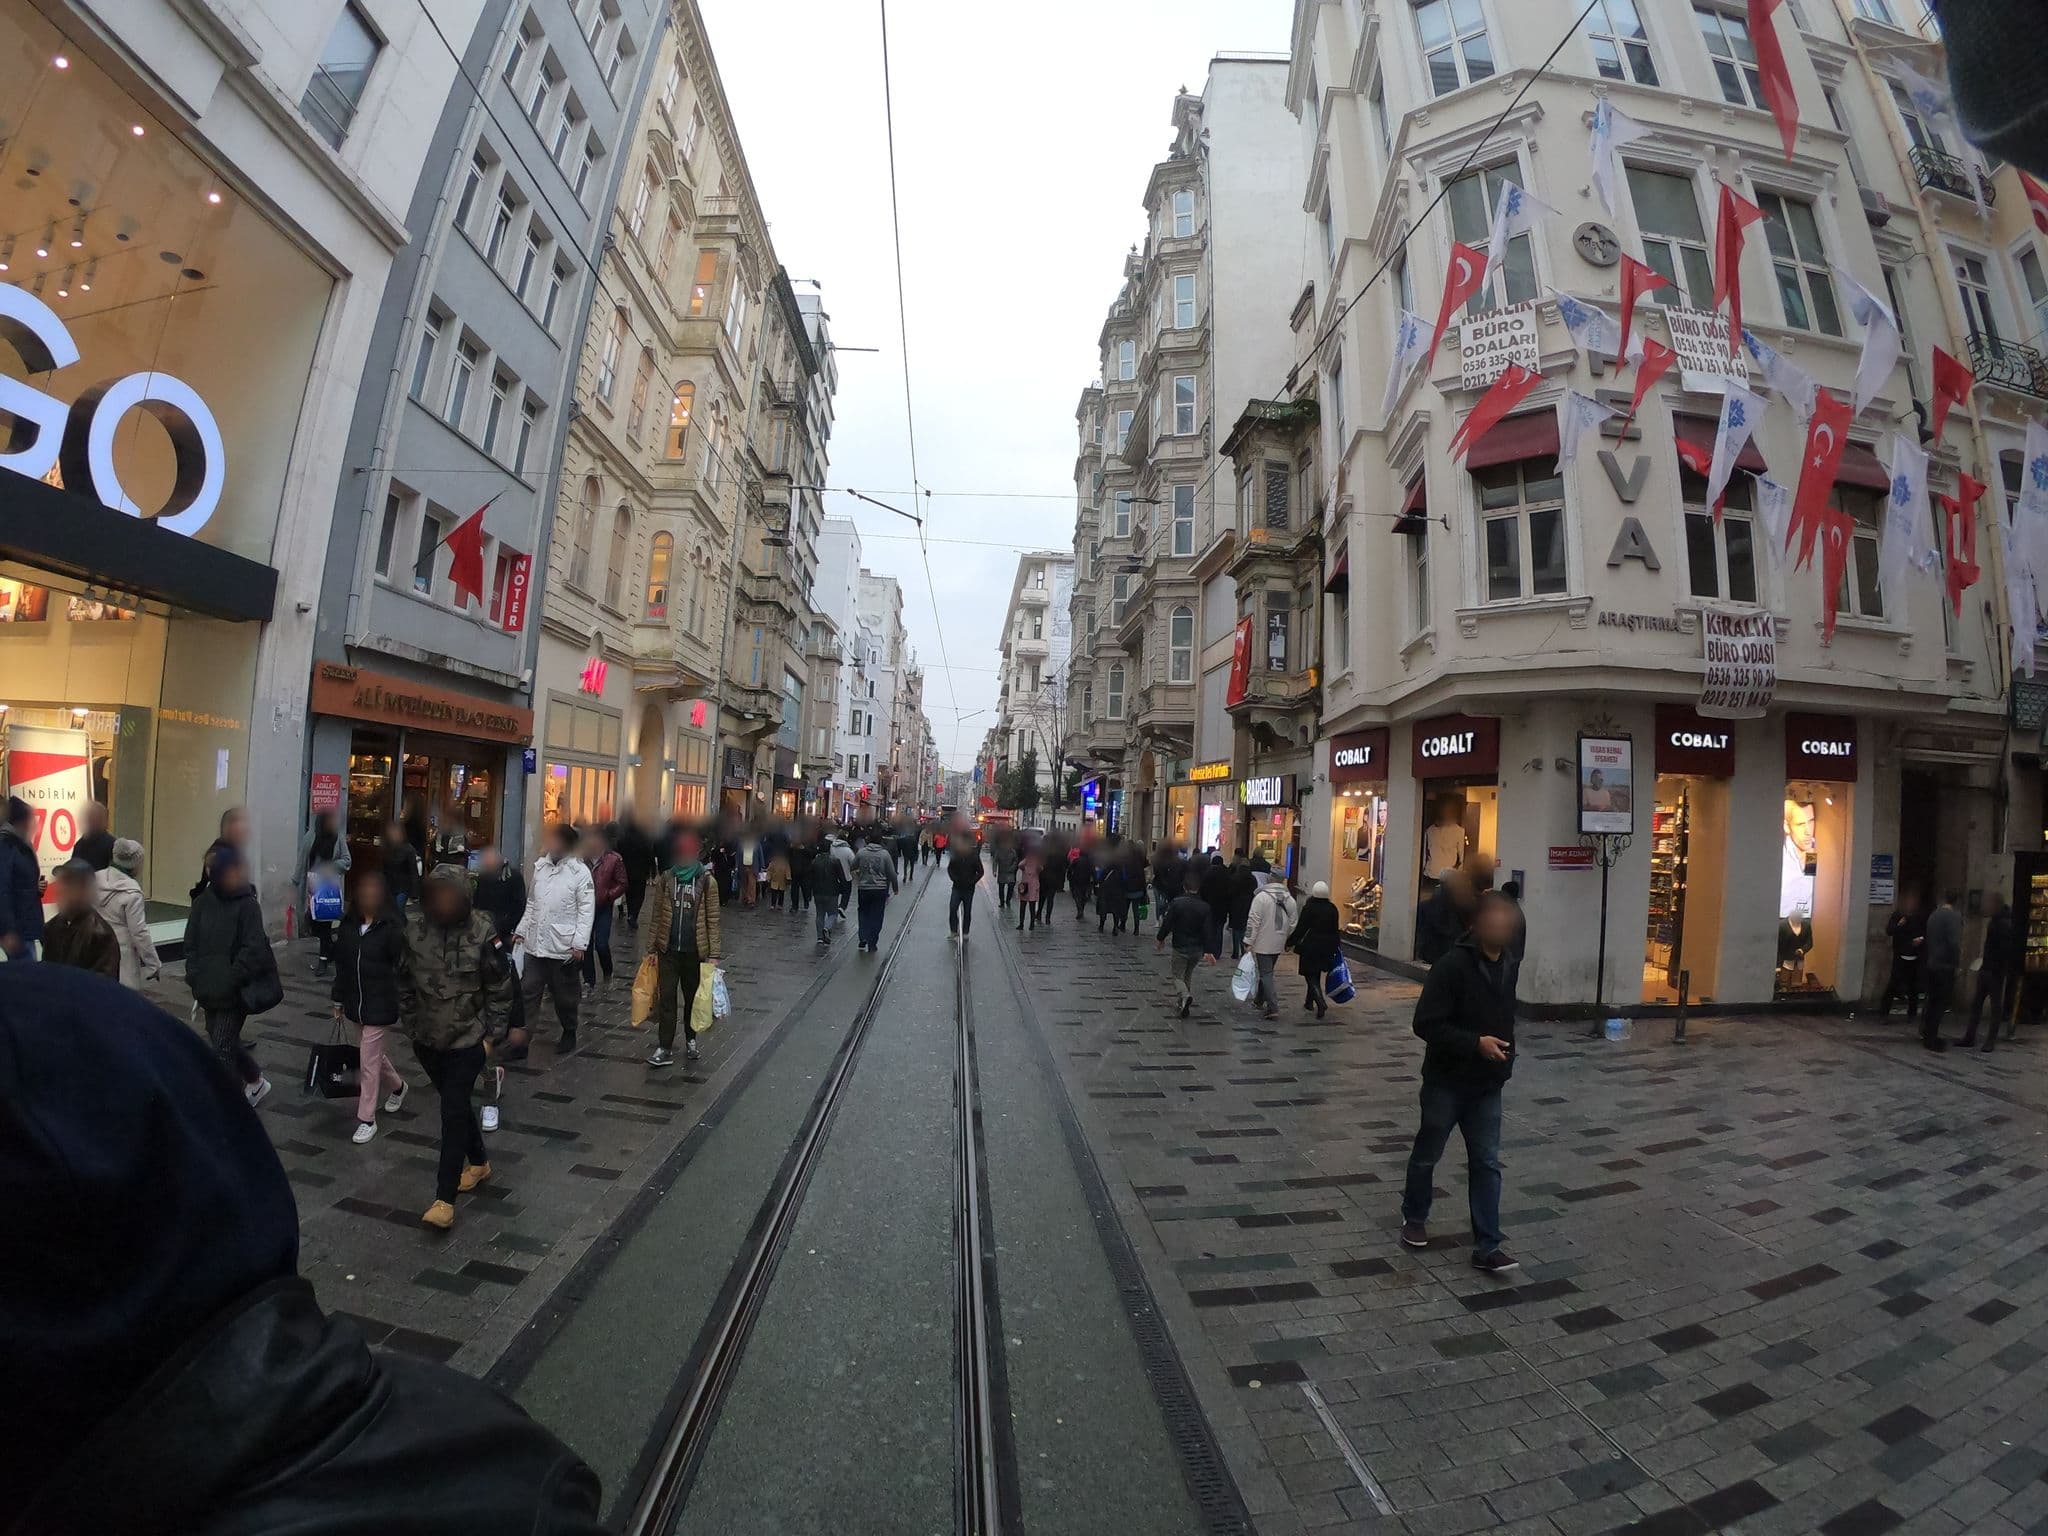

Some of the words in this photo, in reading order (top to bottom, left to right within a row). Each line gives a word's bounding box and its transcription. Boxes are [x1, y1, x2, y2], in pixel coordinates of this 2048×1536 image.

[1472, 319, 1524, 341] BÜRO
[1669, 314, 1701, 337] BÜRO
[1462, 333, 1536, 359] ODALARI
[1675, 336, 1698, 354] 0536
[1699, 340, 1716, 357] 335
[1717, 343, 1729, 360] 90
[1463, 358, 1487, 374] 0536
[1489, 353, 1506, 367] 335
[1507, 350, 1522, 362] 90
[1523, 347, 1537, 360] 26
[1681, 355, 1704, 372] 0212
[1707, 358, 1721, 374] 251
[1735, 363, 1747, 379] 63
[1463, 373, 1488, 389] 0212
[508, 560, 527, 627] NOTER
[1597, 610, 1680, 634] ARAŞTIRMA
[1707, 638, 1740, 664] BÜRO
[1741, 642, 1775, 665] ODASI
[1707, 666, 1731, 687] 0536
[1733, 668, 1751, 687] 335
[1752, 668, 1763, 688] 90
[1764, 669, 1776, 688] 26
[1701, 689, 1728, 706] 0212
[1727, 691, 1746, 708] 251
[1421, 732, 1475, 758] COBALT
[1671, 733, 1729, 749] COBALT
[1801, 741, 1852, 756] COBALT
[1335, 746, 1371, 767] COBALT
[21, 786, 77, 800] İNDİRİM
[1246, 776, 1281, 806] BARGELLO
